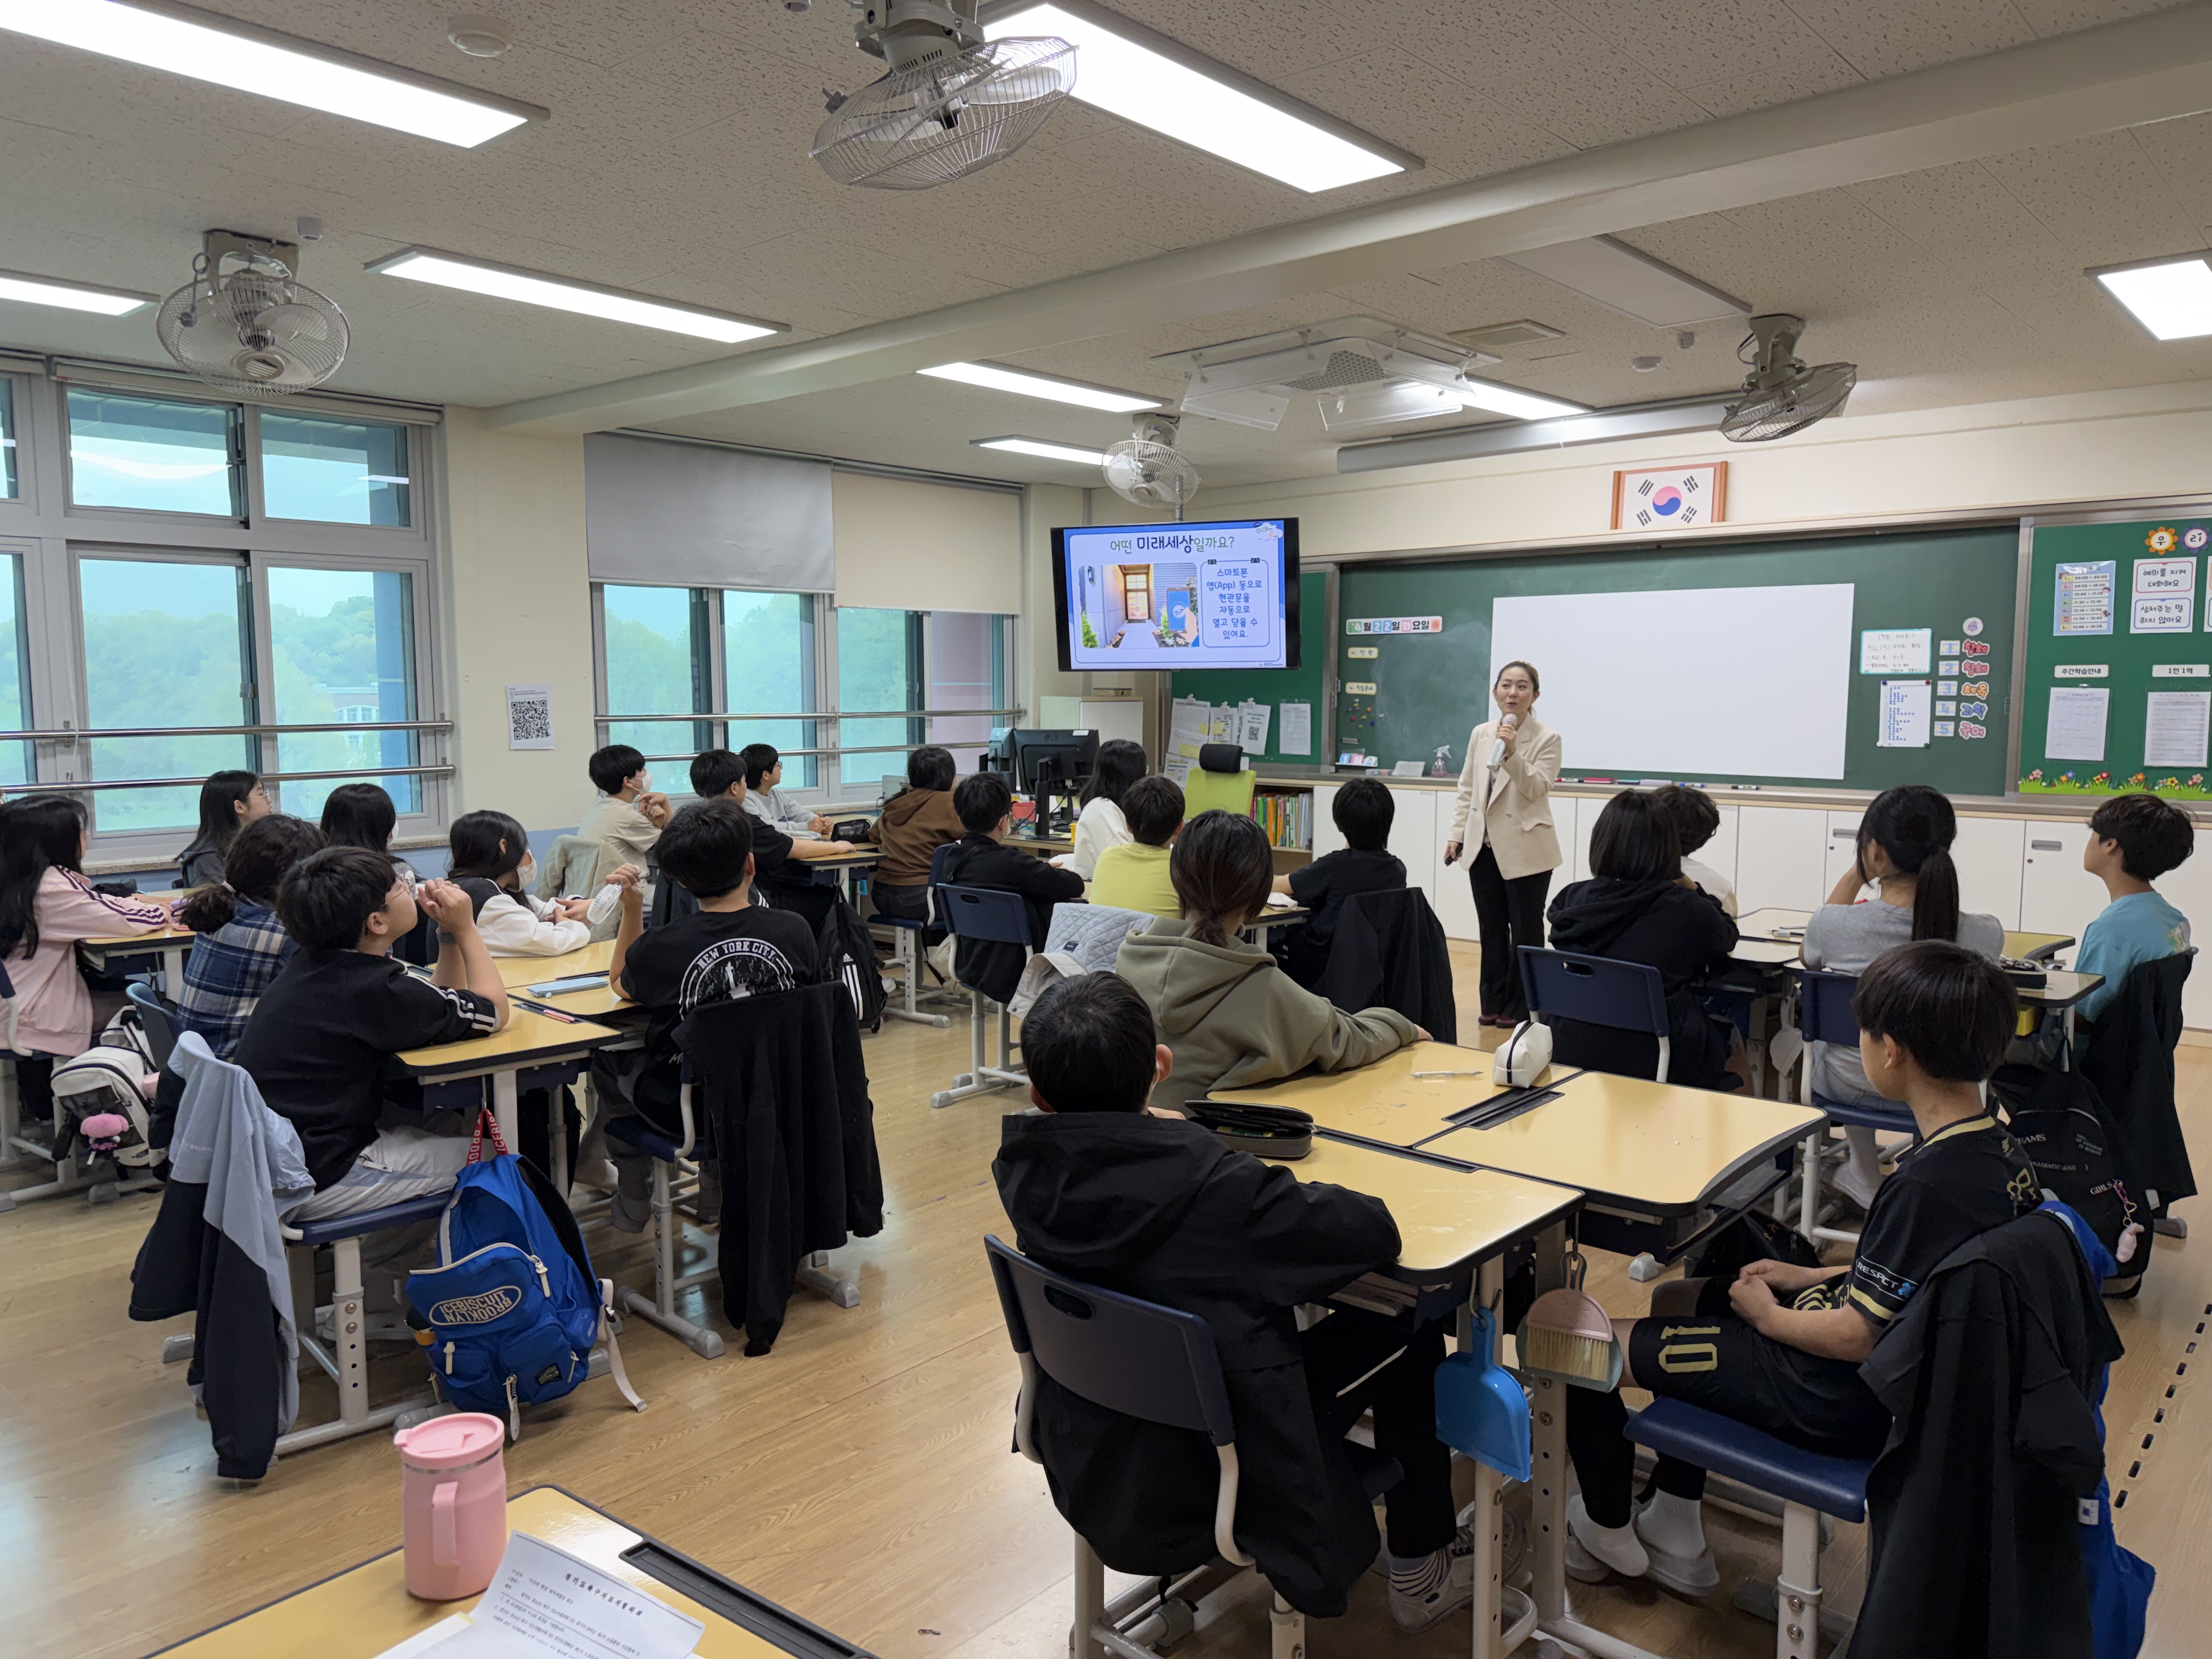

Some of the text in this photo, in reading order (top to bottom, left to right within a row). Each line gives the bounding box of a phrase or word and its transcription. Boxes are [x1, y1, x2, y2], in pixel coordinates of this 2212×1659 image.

[1110, 535, 1234, 554] 어떤 미래세상일까요?
[1217, 568, 1248, 578] 스마트폰
[2143, 568, 2166, 577] 예의를
[1206, 580, 1235, 591] 앱(App)
[1218, 593, 1250, 603] 현관문을
[1219, 605, 1250, 616] 자동으로
[2140, 605, 2183, 613] 상처주는 말
[1212, 617, 1258, 628] 열고 닫을 수
[1354, 620, 1430, 631] 4월 22일 화요일
[2158, 616, 2182, 624] 않아요
[1223, 630, 1249, 640] 있어요.
[696, 941, 776, 969] NEW YORK CITY
[2090, 1182, 2113, 1195] GIRLS
[439, 1290, 505, 1314] ICEBISCUIT
[444, 1297, 512, 1322] BROOKLYN
